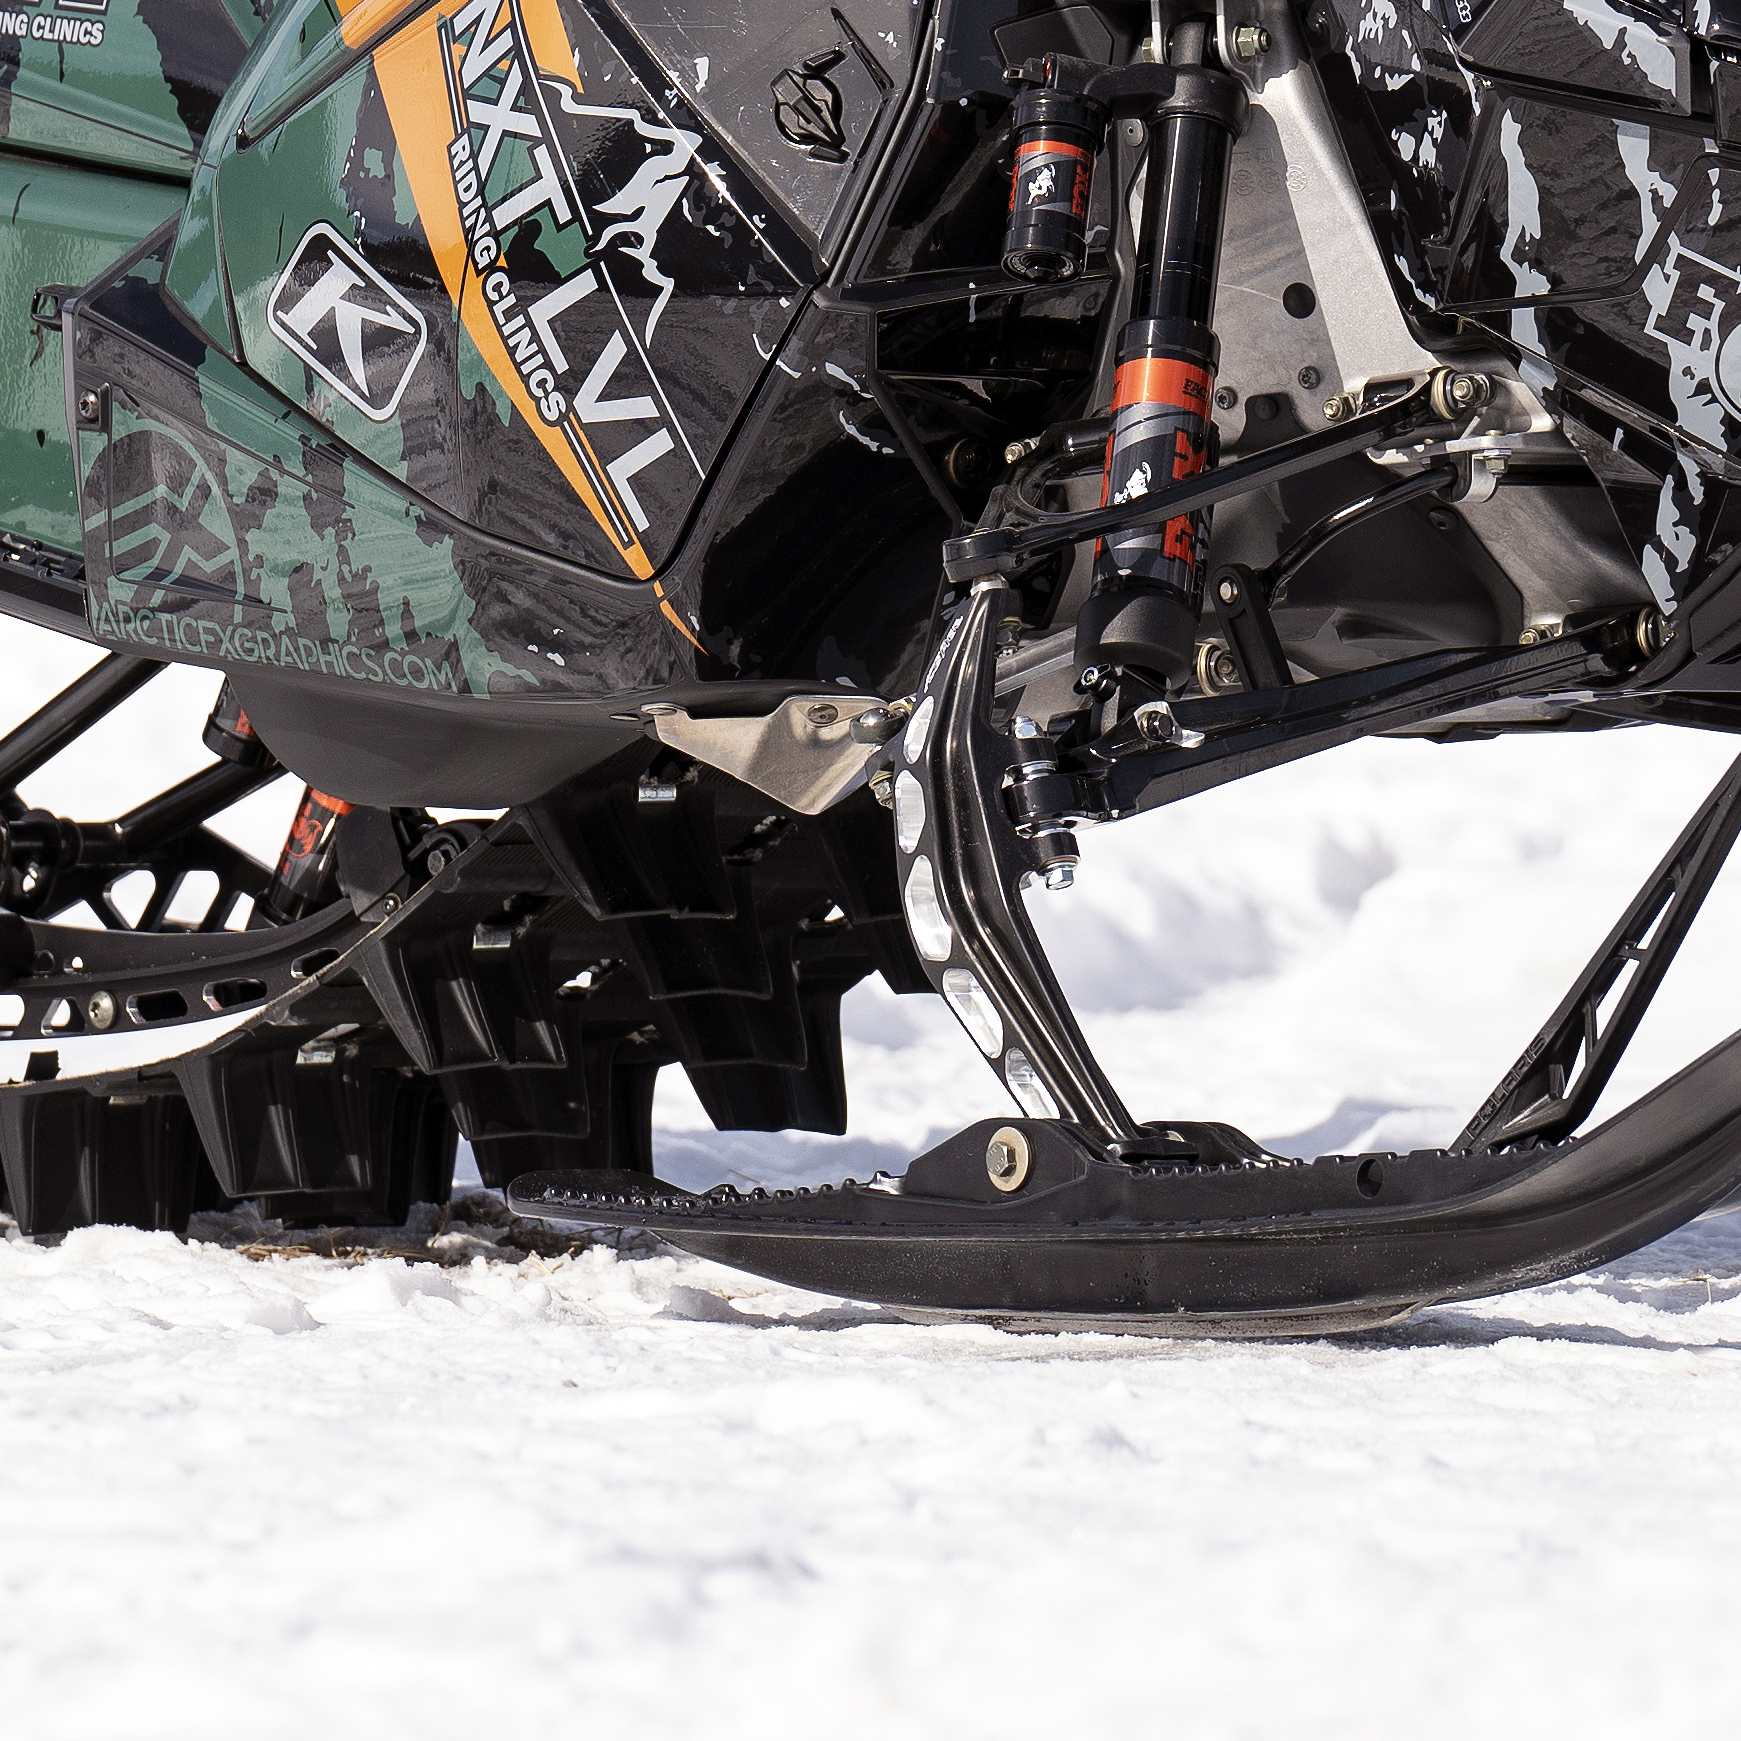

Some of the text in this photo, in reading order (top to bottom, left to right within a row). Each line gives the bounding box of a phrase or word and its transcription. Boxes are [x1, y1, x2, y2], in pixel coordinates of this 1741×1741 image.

[31, 15, 105, 46] CLINICS
[275, 249, 416, 398] K
[451, 137, 565, 425] RIDING CLINICS
[526, 266, 676, 533] LVL
[97, 600, 459, 694] ARCTICFXGRAPHICS.COM
